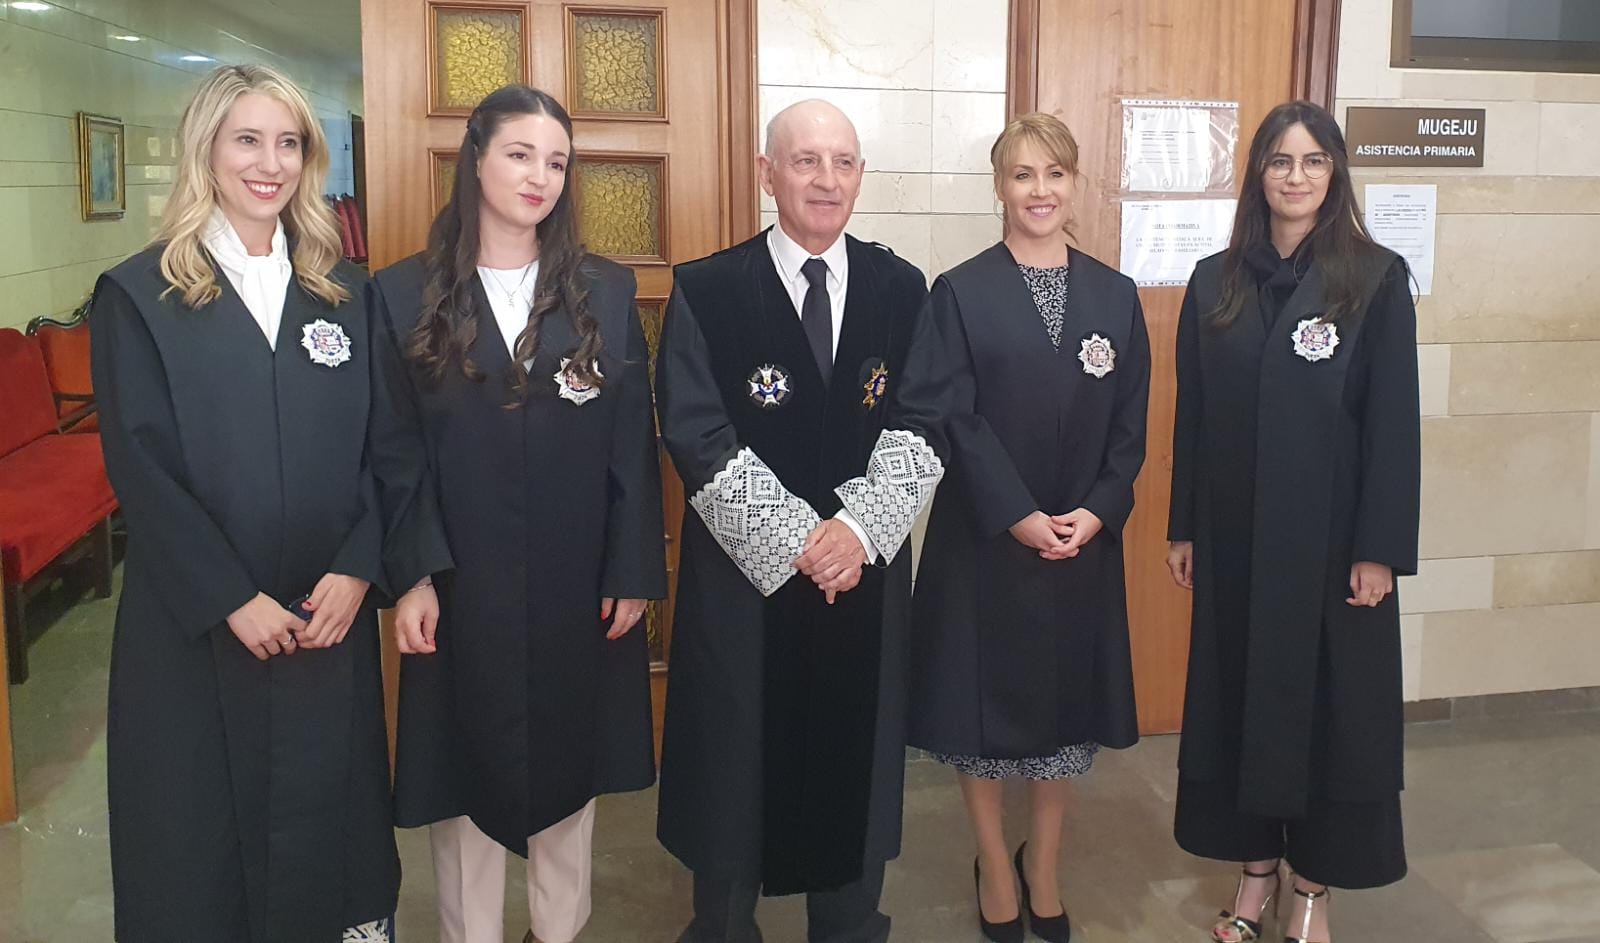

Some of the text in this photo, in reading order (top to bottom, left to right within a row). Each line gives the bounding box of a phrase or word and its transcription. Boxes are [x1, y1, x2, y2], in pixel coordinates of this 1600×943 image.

[1418, 119, 1478, 136] MUGEJU
[1356, 145, 1476, 157] ASISTENCIA PRIMARIA
